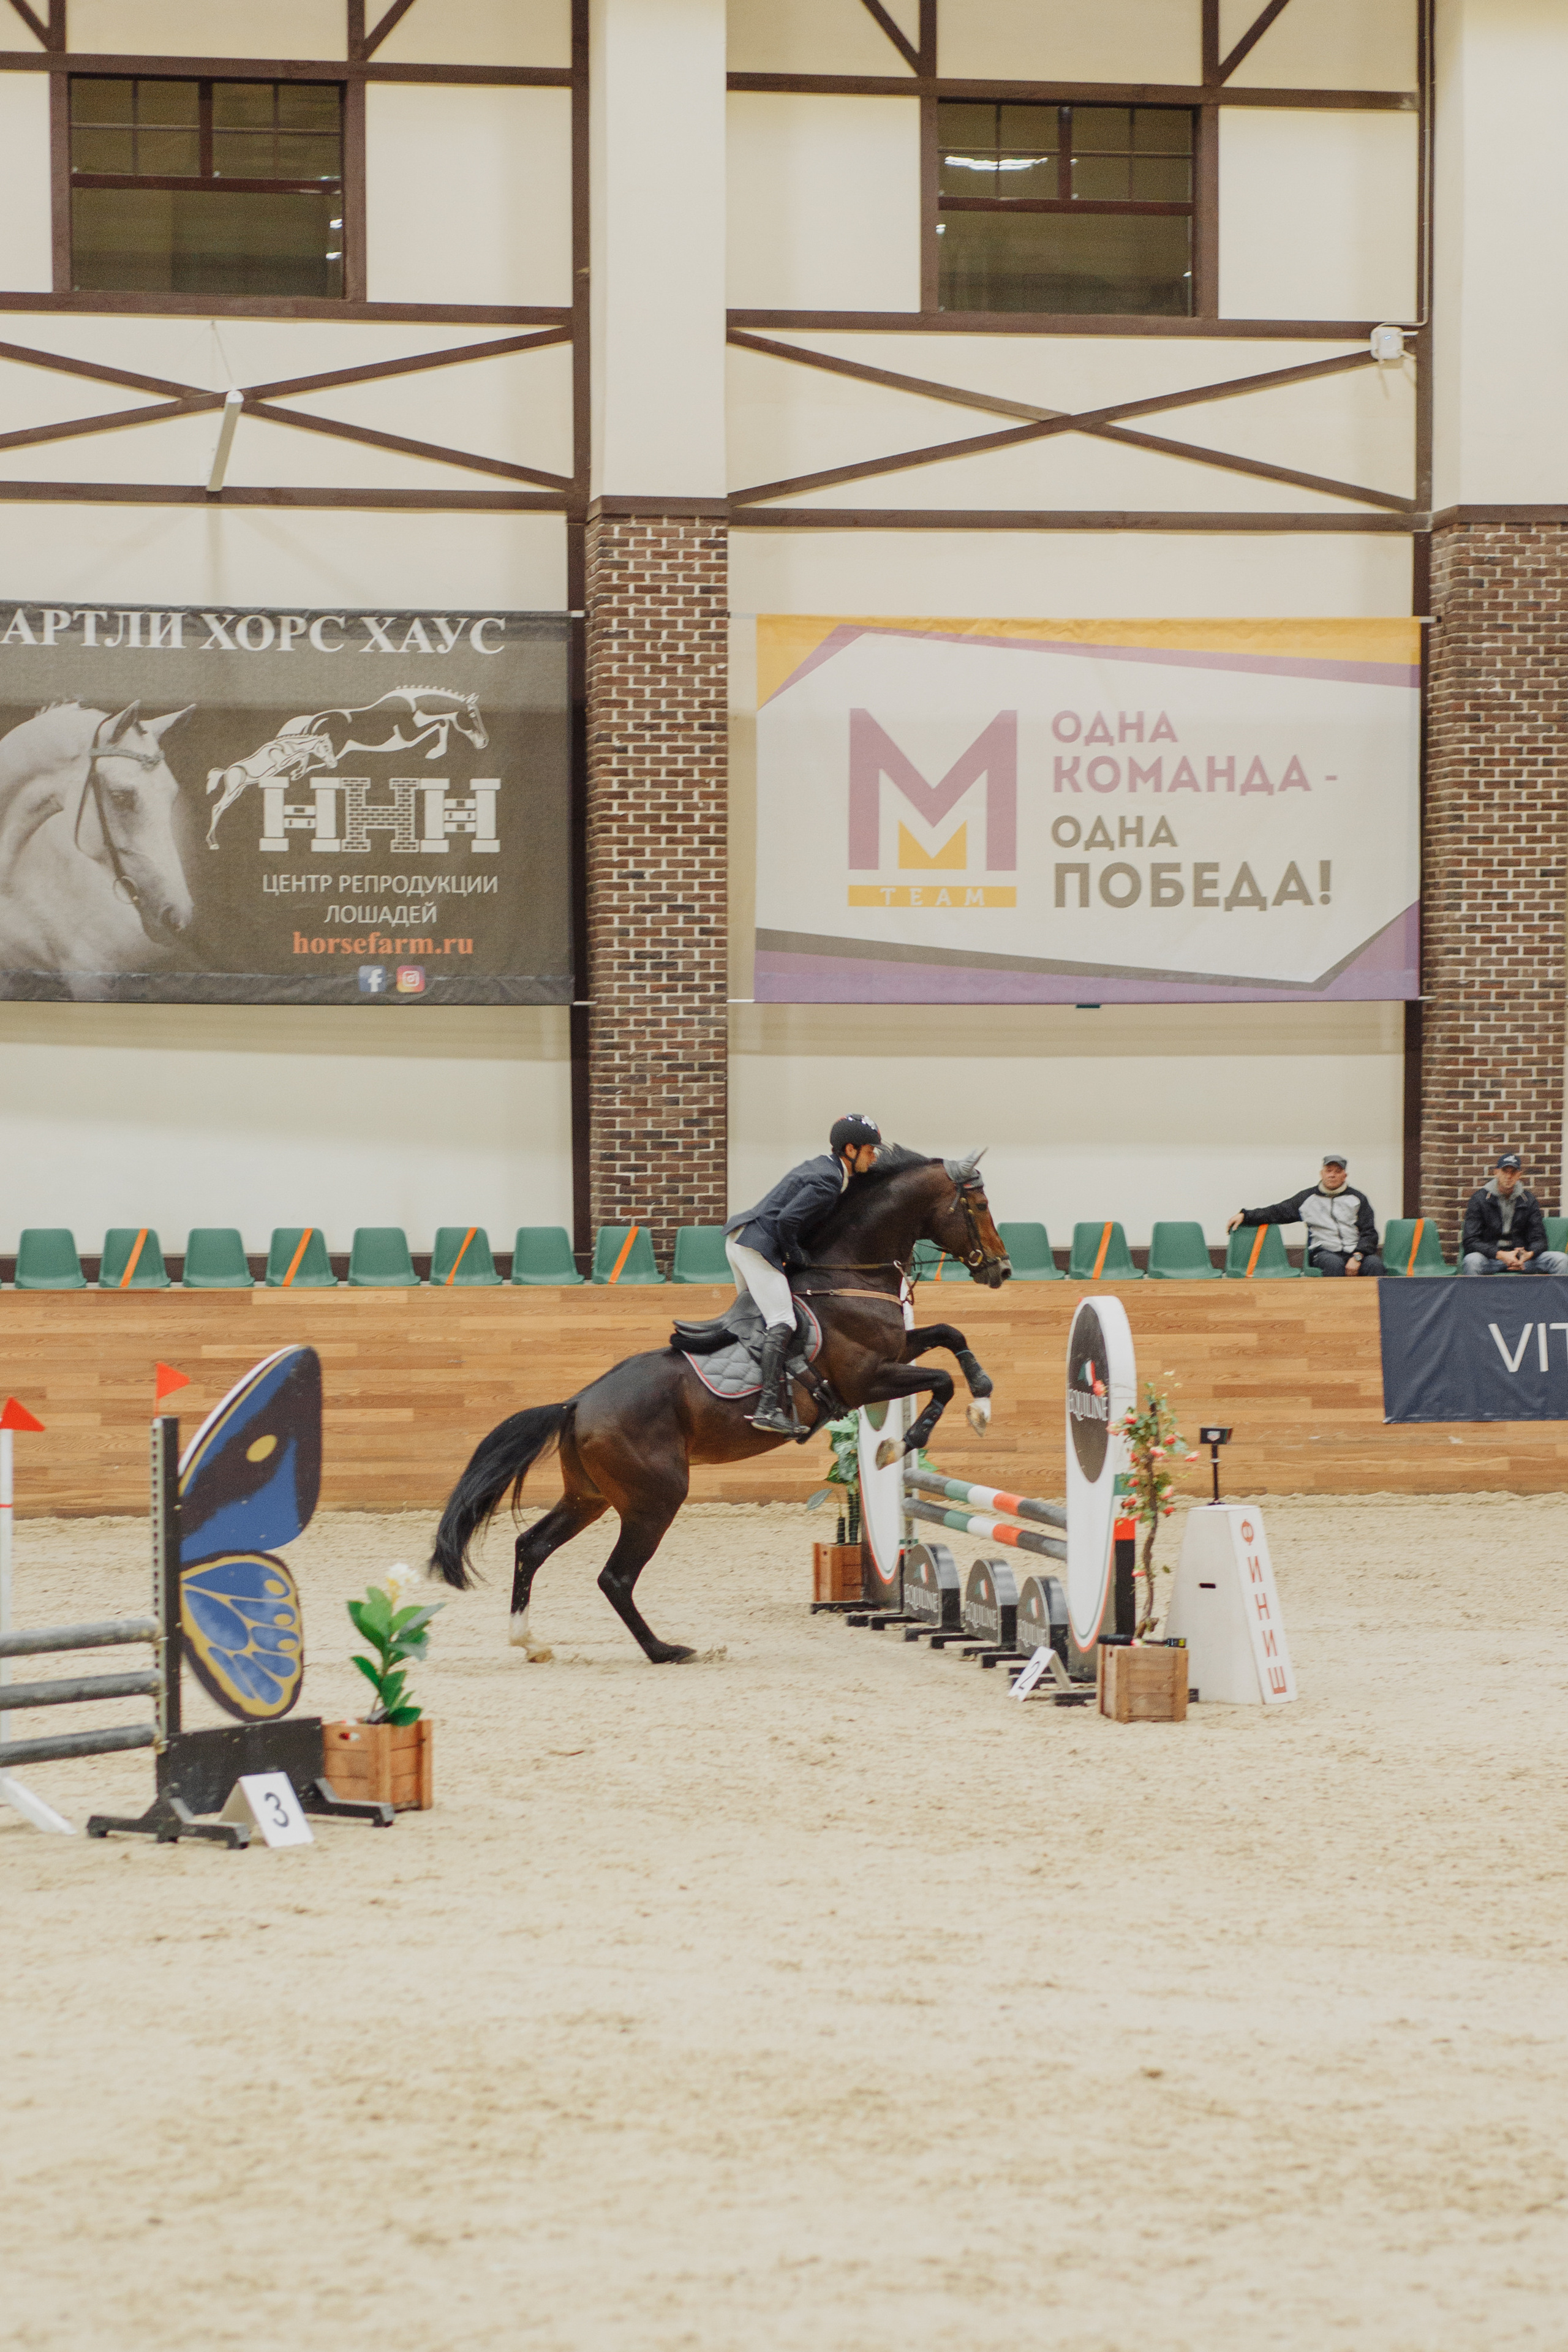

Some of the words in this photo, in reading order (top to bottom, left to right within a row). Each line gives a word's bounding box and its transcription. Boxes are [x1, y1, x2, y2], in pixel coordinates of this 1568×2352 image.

[0, 608, 187, 648] АРТЛИ
[199, 613, 345, 652] ХОРС
[359, 616, 506, 654] ХАУС
[1052, 710, 1178, 746] ОДНА
[1054, 755, 1312, 796] КОМАНДА
[1051, 815, 1178, 851] ОДНА
[262, 874, 333, 896] ЦЕНТР
[339, 875, 498, 897] РЕПРОДУКЦИИ
[880, 888, 985, 906] TEAM
[1054, 860, 1332, 911] ПОБЕДА!
[324, 902, 437, 927] ЛОШАДЕЙ
[293, 932, 473, 954] horsefarm.ru
[1241, 1518, 1287, 1695] ФИНИШ
[1018, 1660, 1040, 1690] 2
[264, 1792, 290, 1828] 3
